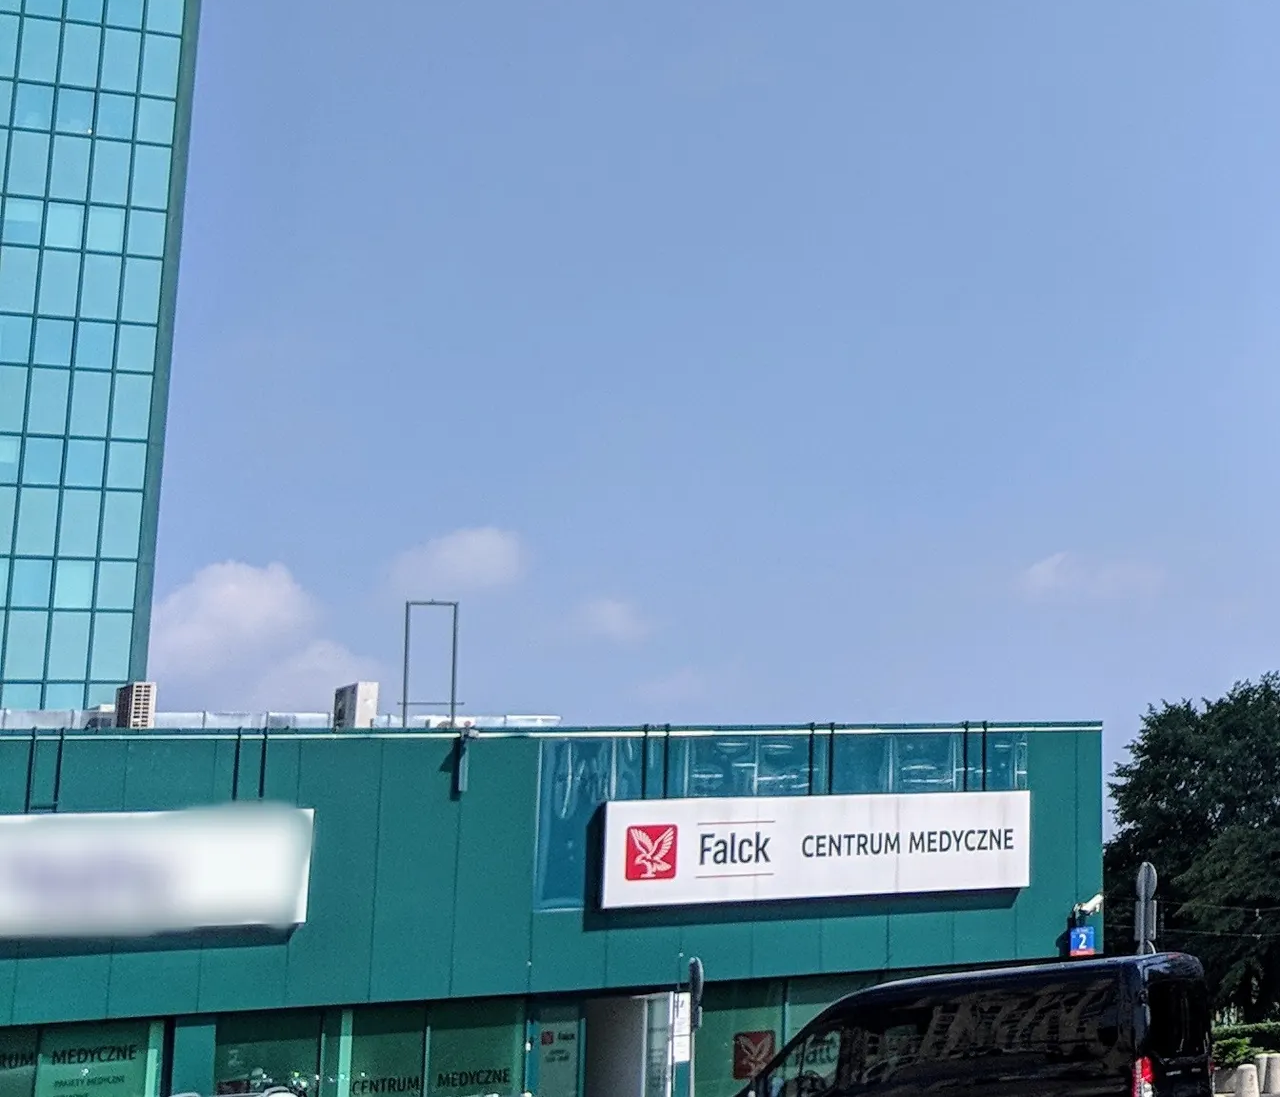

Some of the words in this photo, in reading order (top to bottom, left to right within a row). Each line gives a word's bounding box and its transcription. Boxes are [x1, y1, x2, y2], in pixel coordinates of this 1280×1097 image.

[699, 831, 771, 866] Falck
[801, 832, 900, 858] CENTRUM
[908, 828, 1014, 854] MEDYCZNE
[1079, 933, 1088, 949] 2
[52, 1045, 137, 1065] MEDYCZNE
[352, 1076, 421, 1095] CENTRUM
[437, 1068, 510, 1088] MEDYCZNE
